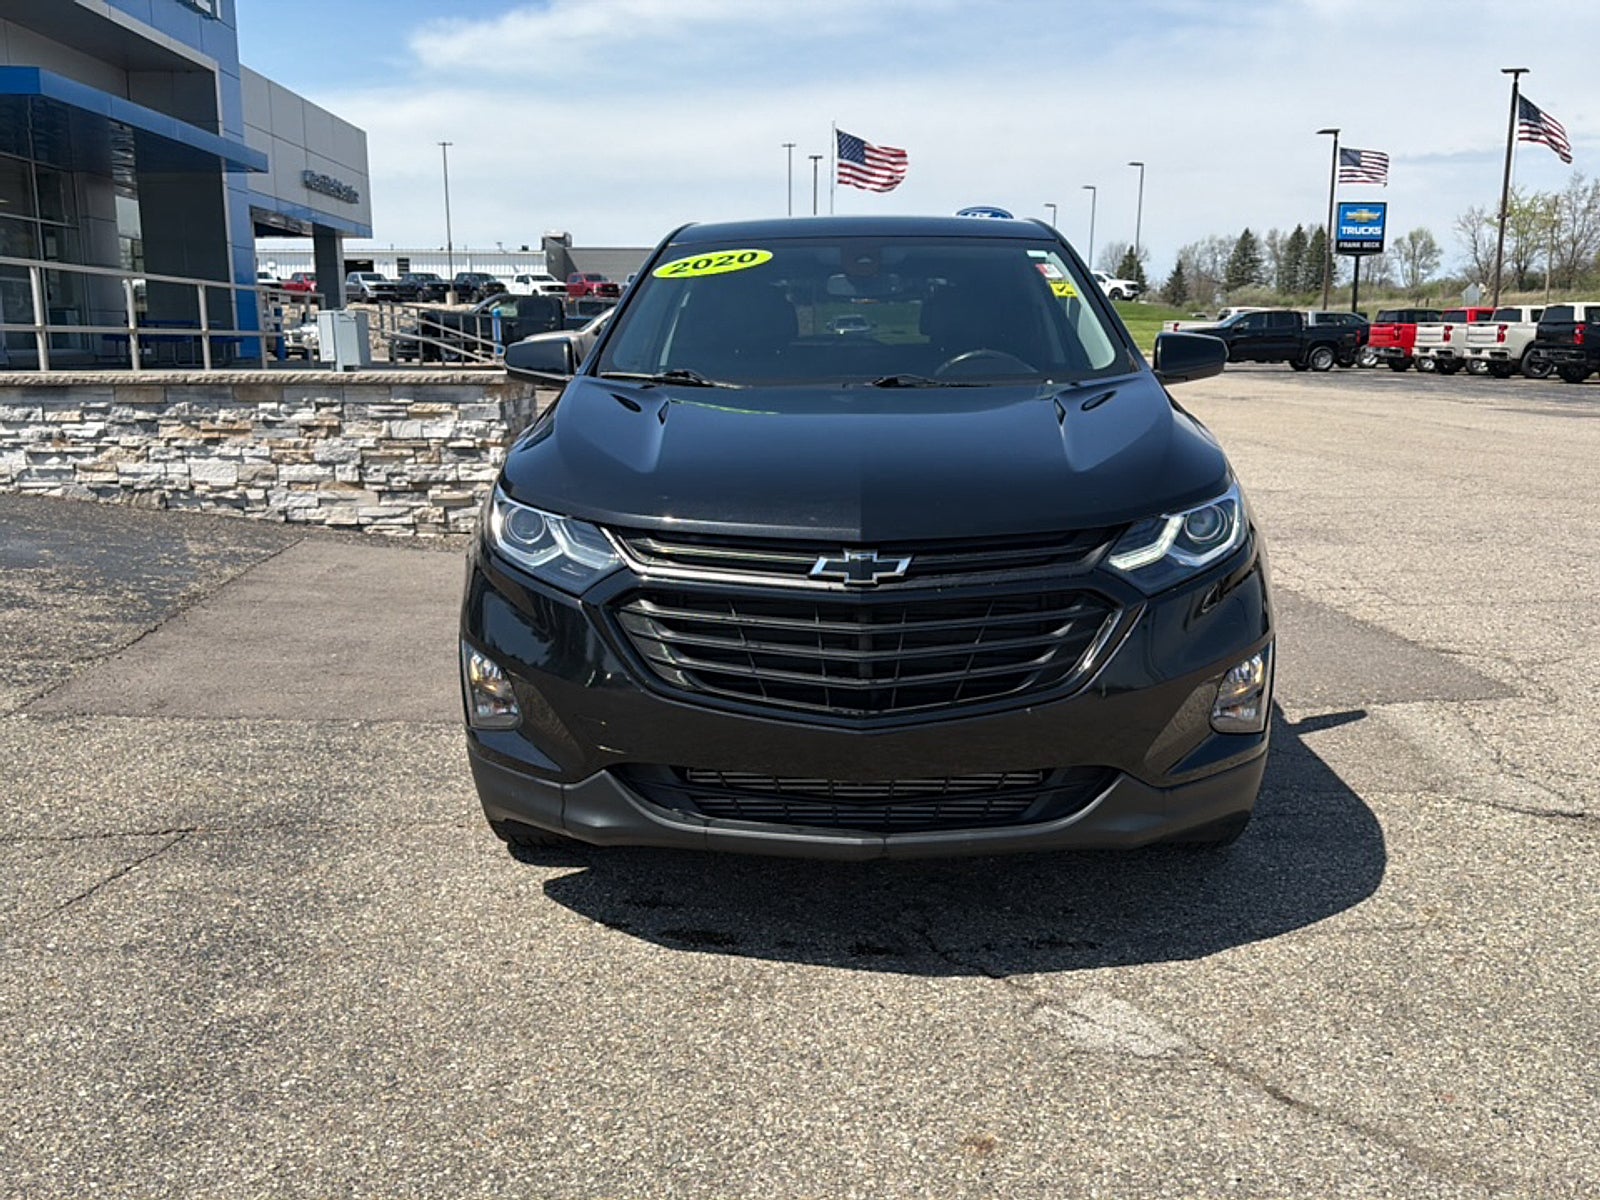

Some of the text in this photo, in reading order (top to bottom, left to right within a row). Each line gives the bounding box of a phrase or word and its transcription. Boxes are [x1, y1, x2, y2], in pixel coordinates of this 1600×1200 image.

[1341, 226, 1382, 235] TRUCKS
[1338, 241, 1361, 249] FRANK
[668, 252, 758, 274] 2020
